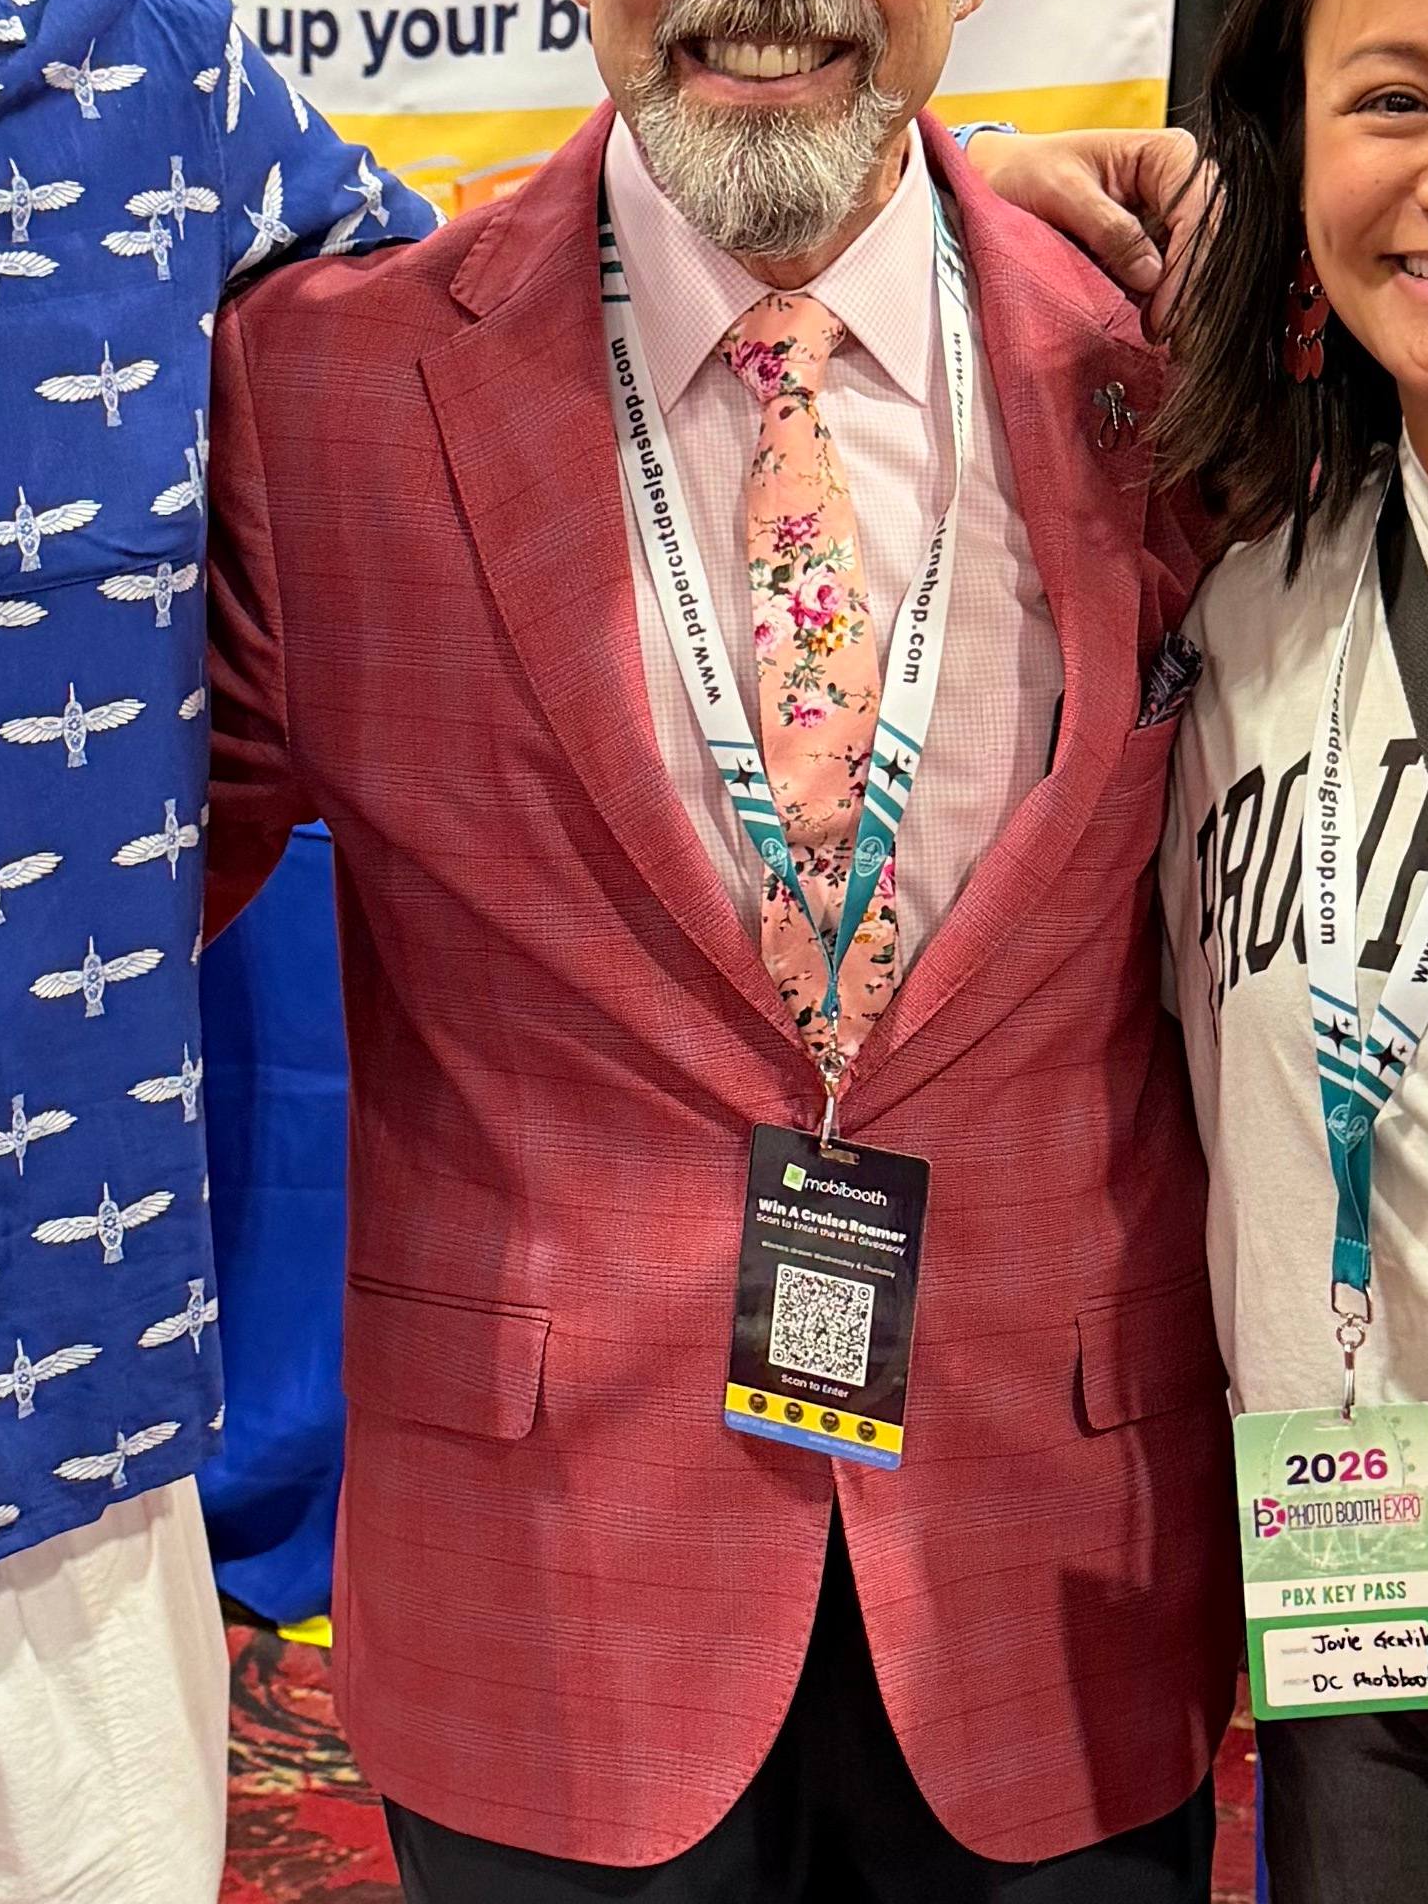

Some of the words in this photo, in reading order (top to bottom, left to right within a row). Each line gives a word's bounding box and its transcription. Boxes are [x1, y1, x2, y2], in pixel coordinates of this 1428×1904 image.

[258, 5, 339, 76] up
[361, 0, 519, 77] your
[611, 337, 722, 705] www.papercutdesignshop.com
[804, 1178, 888, 1207] mobibooth
[756, 1212, 780, 1228] Scan
[758, 1197, 787, 1216] Win
[788, 1205, 800, 1220] A
[801, 1209, 848, 1230] Cruise
[848, 1218, 908, 1243] Roamer
[780, 1373, 808, 1389] Scan
[809, 1380, 822, 1393] to
[822, 1383, 850, 1399] Enter
[1285, 1448, 1389, 1486] 2026
[1287, 1502, 1333, 1527] PHOTO
[1335, 1499, 1382, 1524] BOOTH
[1383, 1496, 1422, 1520] EXPO
[1282, 1586, 1316, 1607] PBX
[1323, 1584, 1357, 1604] KEY
[1363, 1581, 1408, 1602] PASS
[1311, 1627, 1363, 1654] Jovie
[1312, 1673, 1344, 1693] DC
